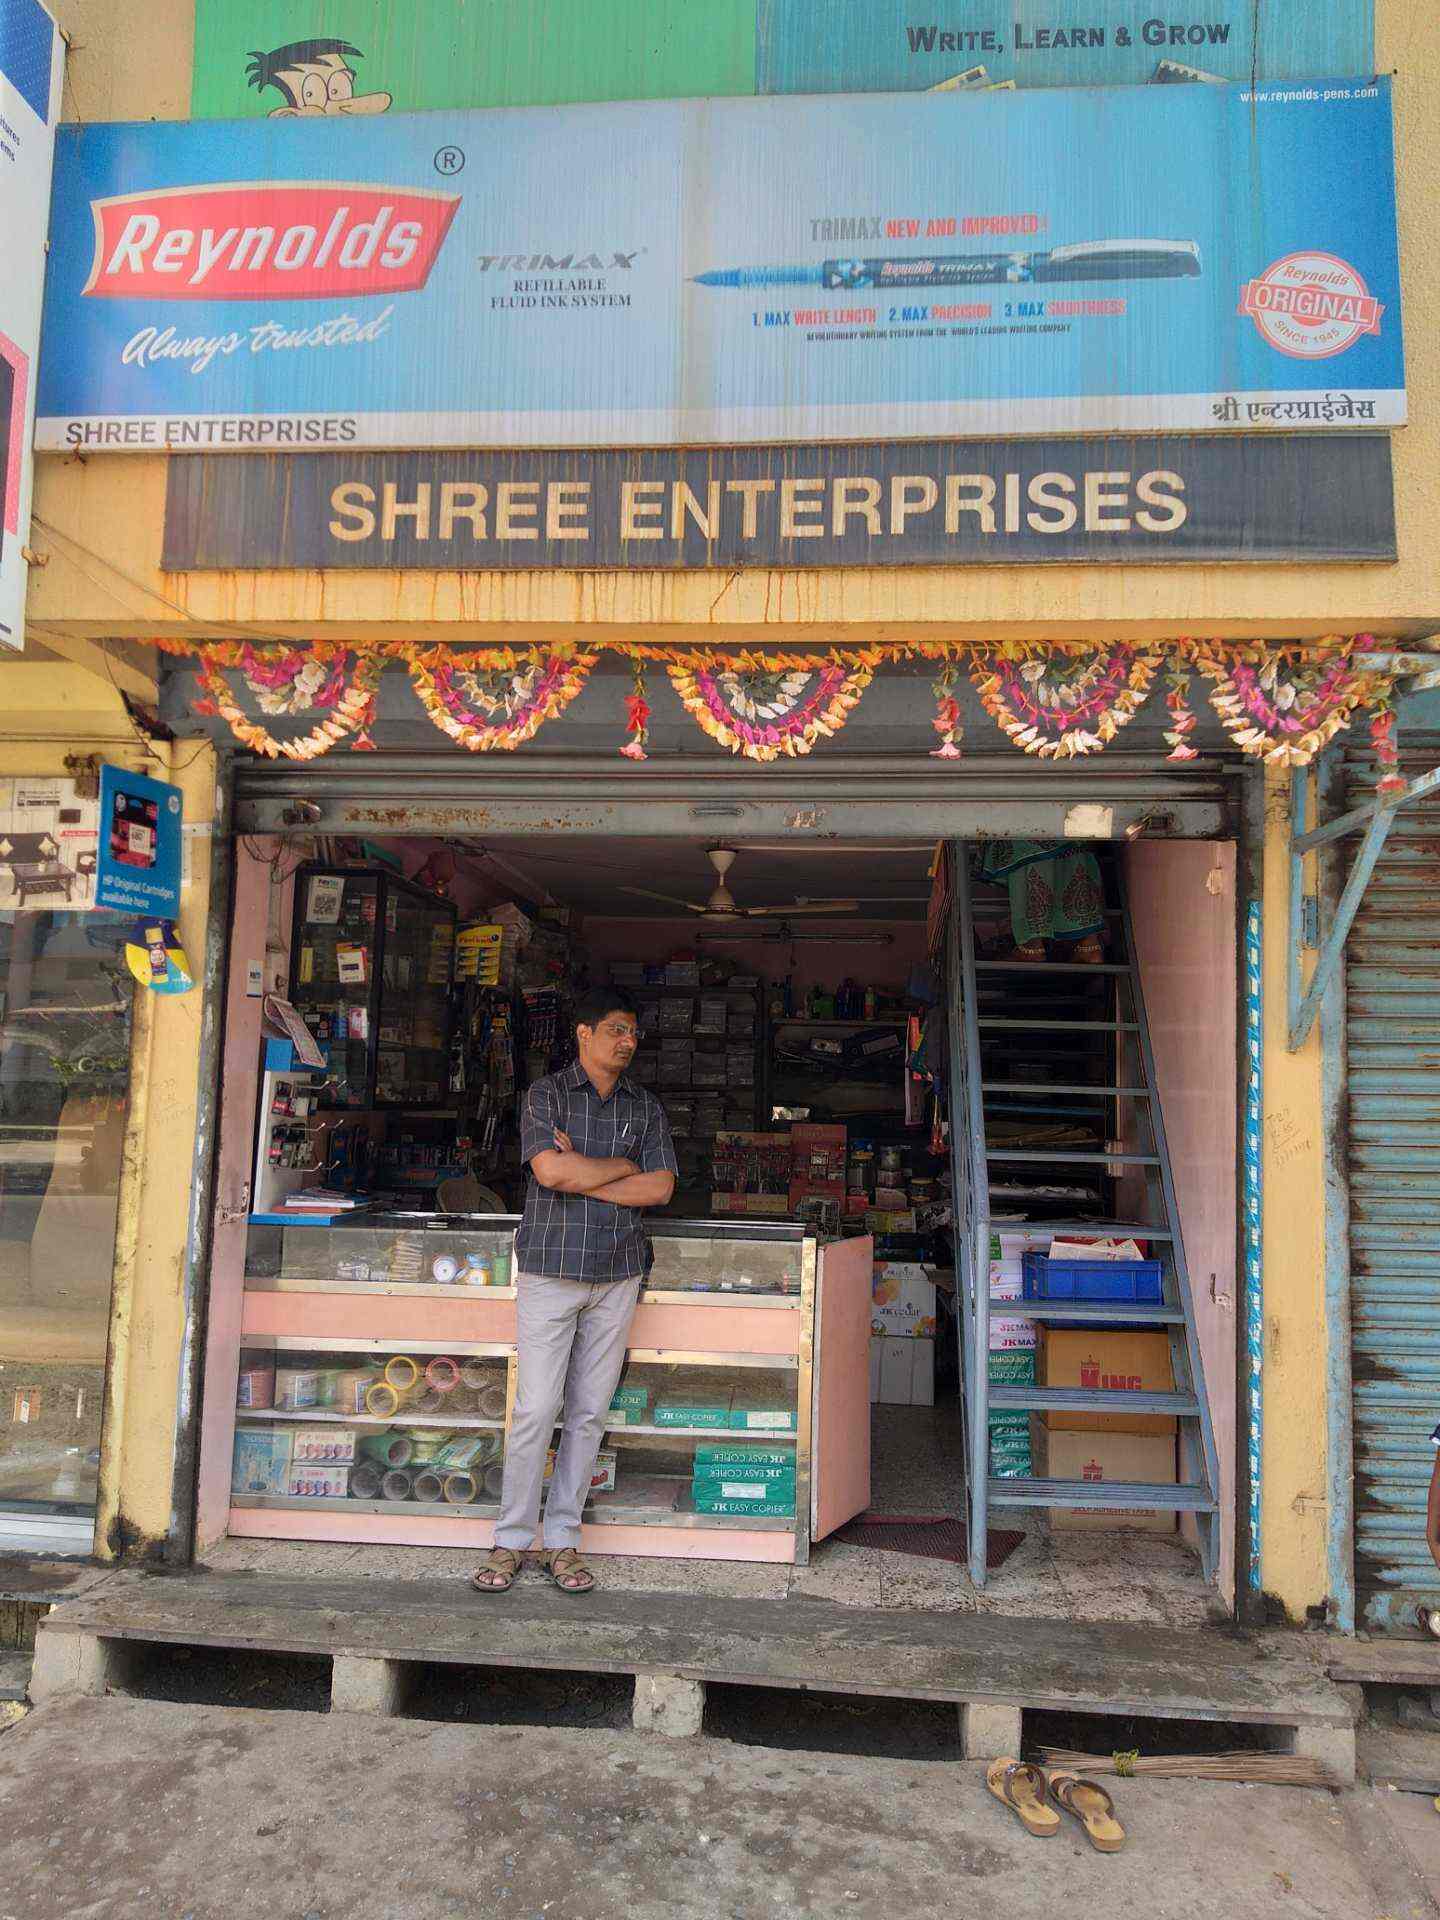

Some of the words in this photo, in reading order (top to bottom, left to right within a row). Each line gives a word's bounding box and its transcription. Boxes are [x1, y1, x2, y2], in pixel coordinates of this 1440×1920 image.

[907, 23, 1004, 53] WRITE,
[1014, 23, 1105, 49] LEARN
[1115, 26, 1132, 47] &
[1142, 18, 1231, 46] GROW
[1240, 86, 1379, 103] www.reynolds-pens.com
[811, 216, 882, 241] TRIMAX
[886, 219, 920, 241] NEW
[926, 218, 956, 239] AND
[961, 214, 1038, 236] IMPROVED
[105, 206, 424, 285] Reynolds
[477, 252, 638, 272] TRIMAX
[514, 278, 607, 293] REFILLABLE
[1282, 265, 1350, 287] Reynolds
[491, 295, 537, 309] FLUID
[541, 295, 569, 309] INK
[571, 294, 632, 307] SYSTEM
[1018, 302, 1045, 317] MAX
[1254, 285, 1370, 323] ORIGINAL
[765, 310, 791, 327] MAX
[794, 309, 830, 326] WRITE
[834, 307, 877, 326] LENGTH
[902, 305, 928, 321] MAX
[122, 325, 246, 374] Always
[250, 303, 395, 352] trusted
[1274, 320, 1309, 345] SINCE
[1212, 396, 1241, 422] श्री
[66, 420, 156, 445] SHREE
[165, 418, 357, 443] ENTERPRISES
[328, 481, 592, 542] SHREE
[620, 470, 1189, 541] ENTERPRISES
[1002, 1338, 1017, 1347] JK
[771, 1455, 786, 1464] JK
[710, 1469, 743, 1478] COPIER
[745, 1469, 765, 1478] EASY
[766, 1469, 783, 1478] JK
[712, 1502, 728, 1512] JK
[729, 1503, 750, 1512] EASY
[752, 1504, 785, 1513] COPIER
